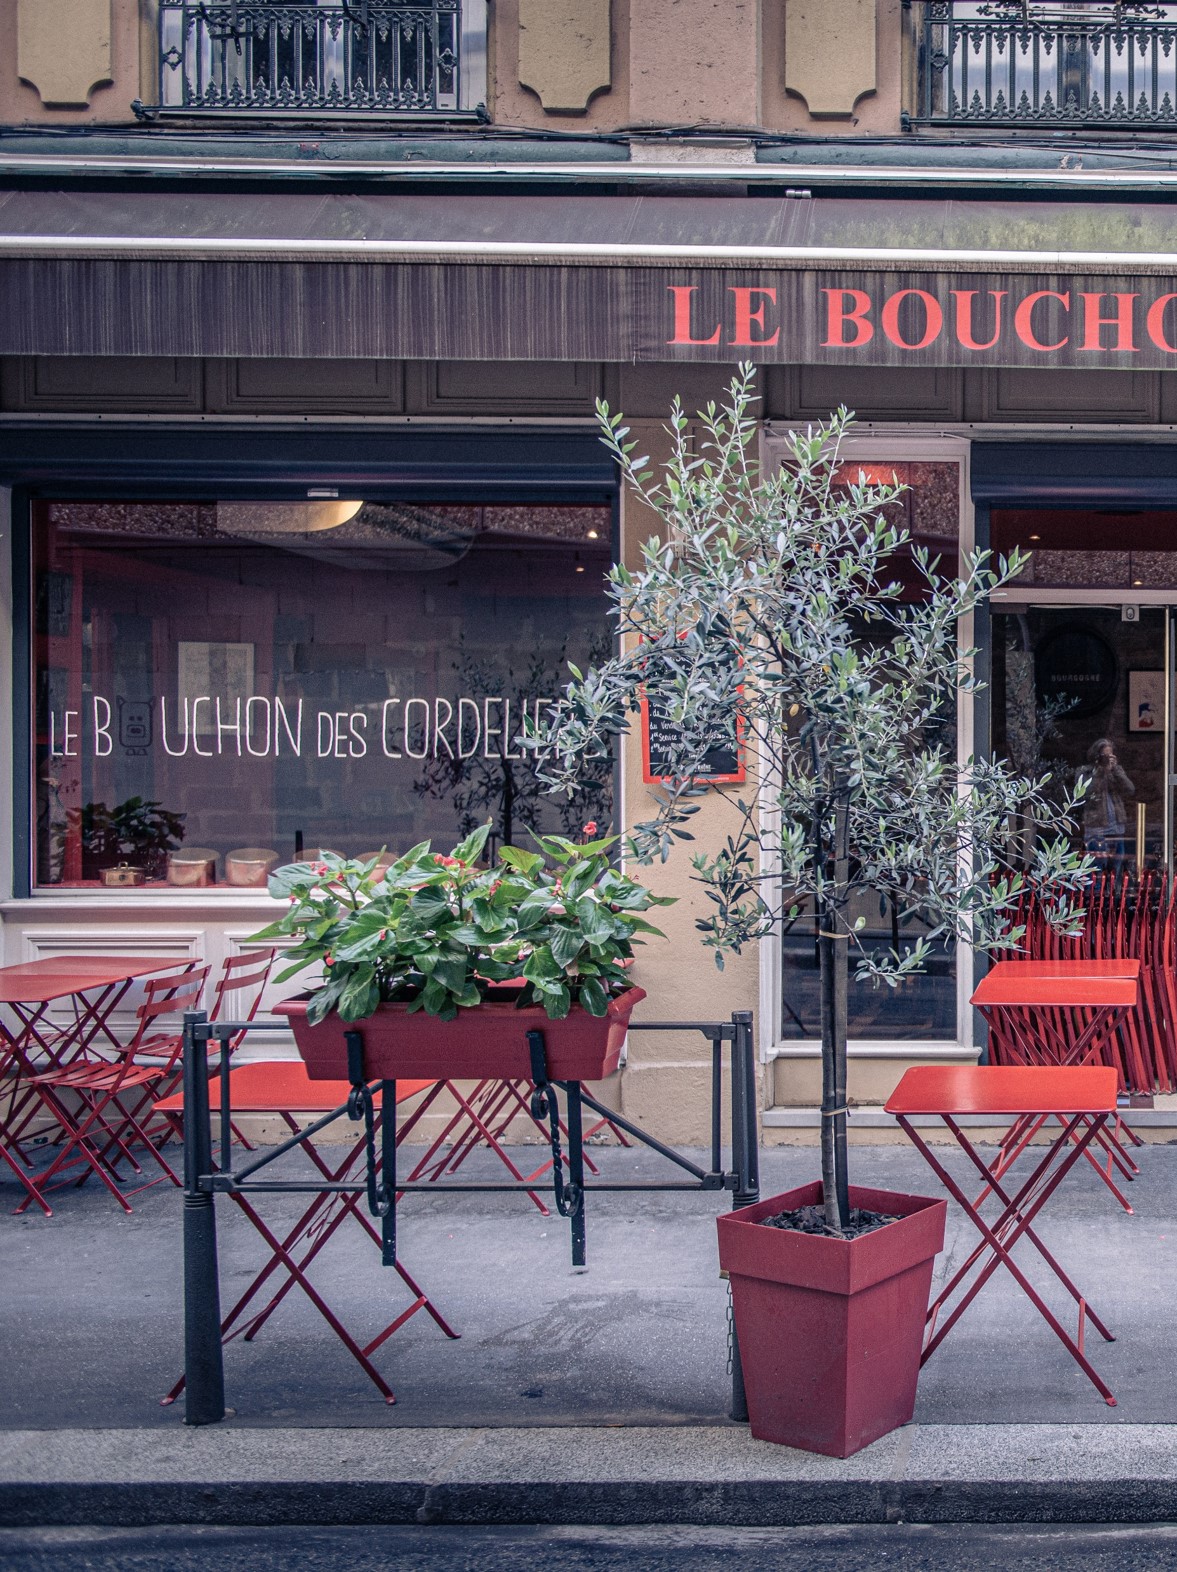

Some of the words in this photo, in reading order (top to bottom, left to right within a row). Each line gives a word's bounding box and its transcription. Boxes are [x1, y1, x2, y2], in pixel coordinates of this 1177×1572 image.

[666, 286, 781, 346] LE
[1051, 673, 1101, 682] BOURGOGNE
[51, 711, 78, 756] LE
[318, 712, 367, 757] DES
[382, 698, 600, 759] CORDELIE
[659, 733, 677, 741] Service
